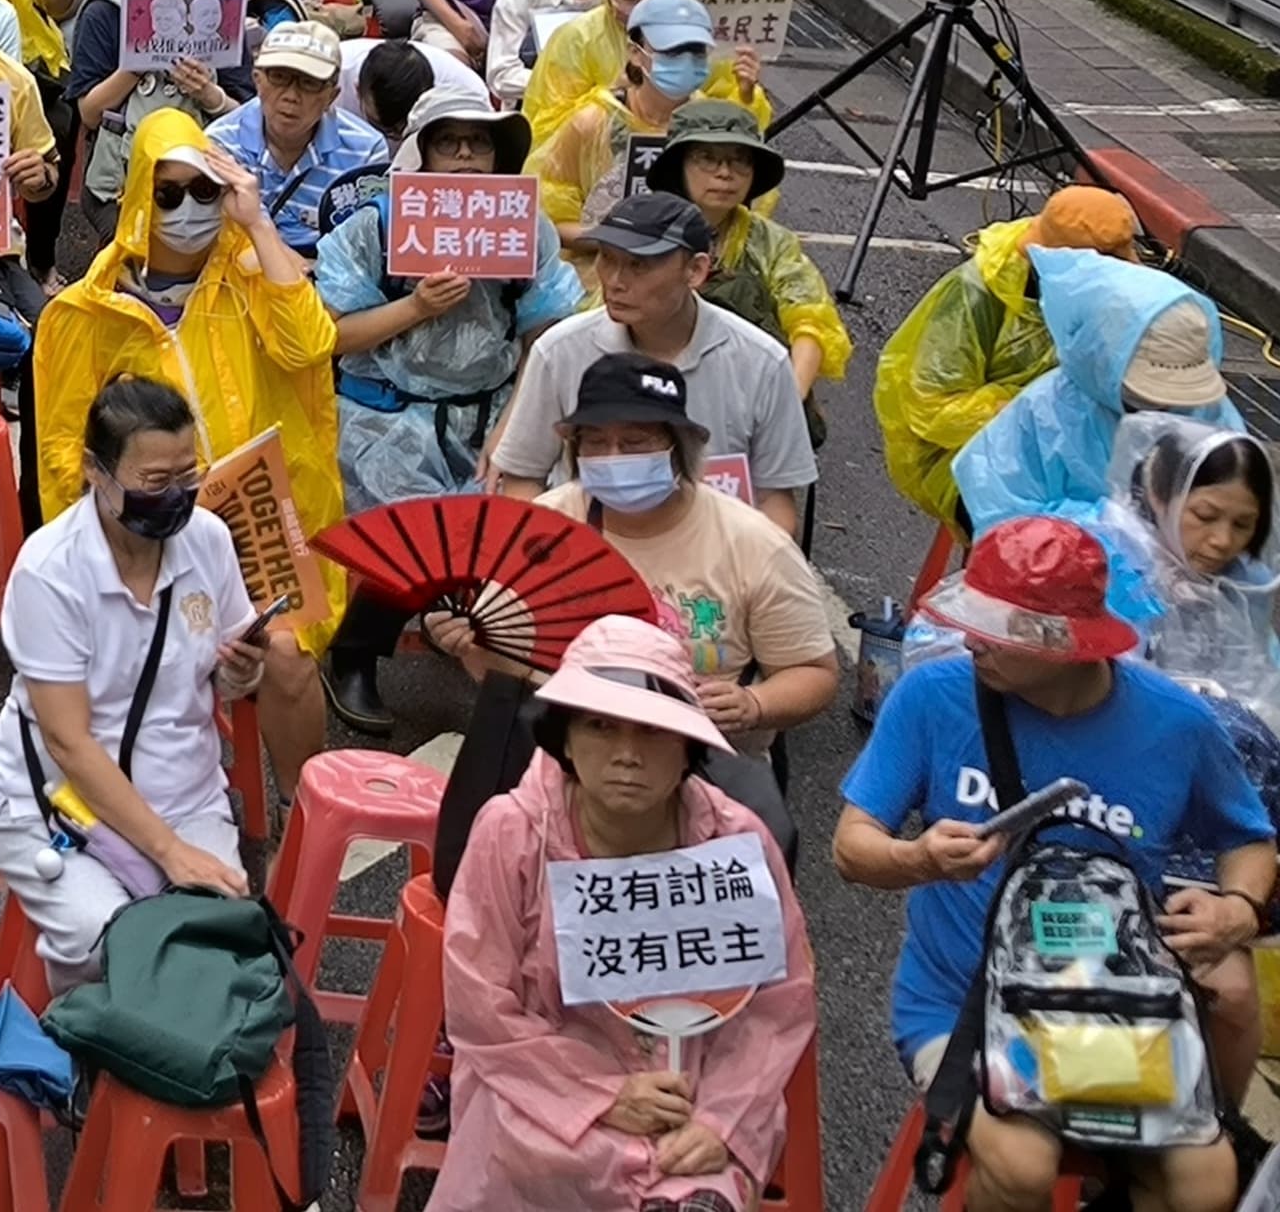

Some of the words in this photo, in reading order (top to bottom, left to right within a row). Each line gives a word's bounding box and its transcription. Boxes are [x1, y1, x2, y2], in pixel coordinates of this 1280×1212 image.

[398, 187, 531, 221] 台灣內政
[397, 224, 530, 258] 人民作主
[641, 375, 679, 396] FILA
[573, 855, 757, 917] 沒有討論
[583, 921, 766, 979] 沒有民主
